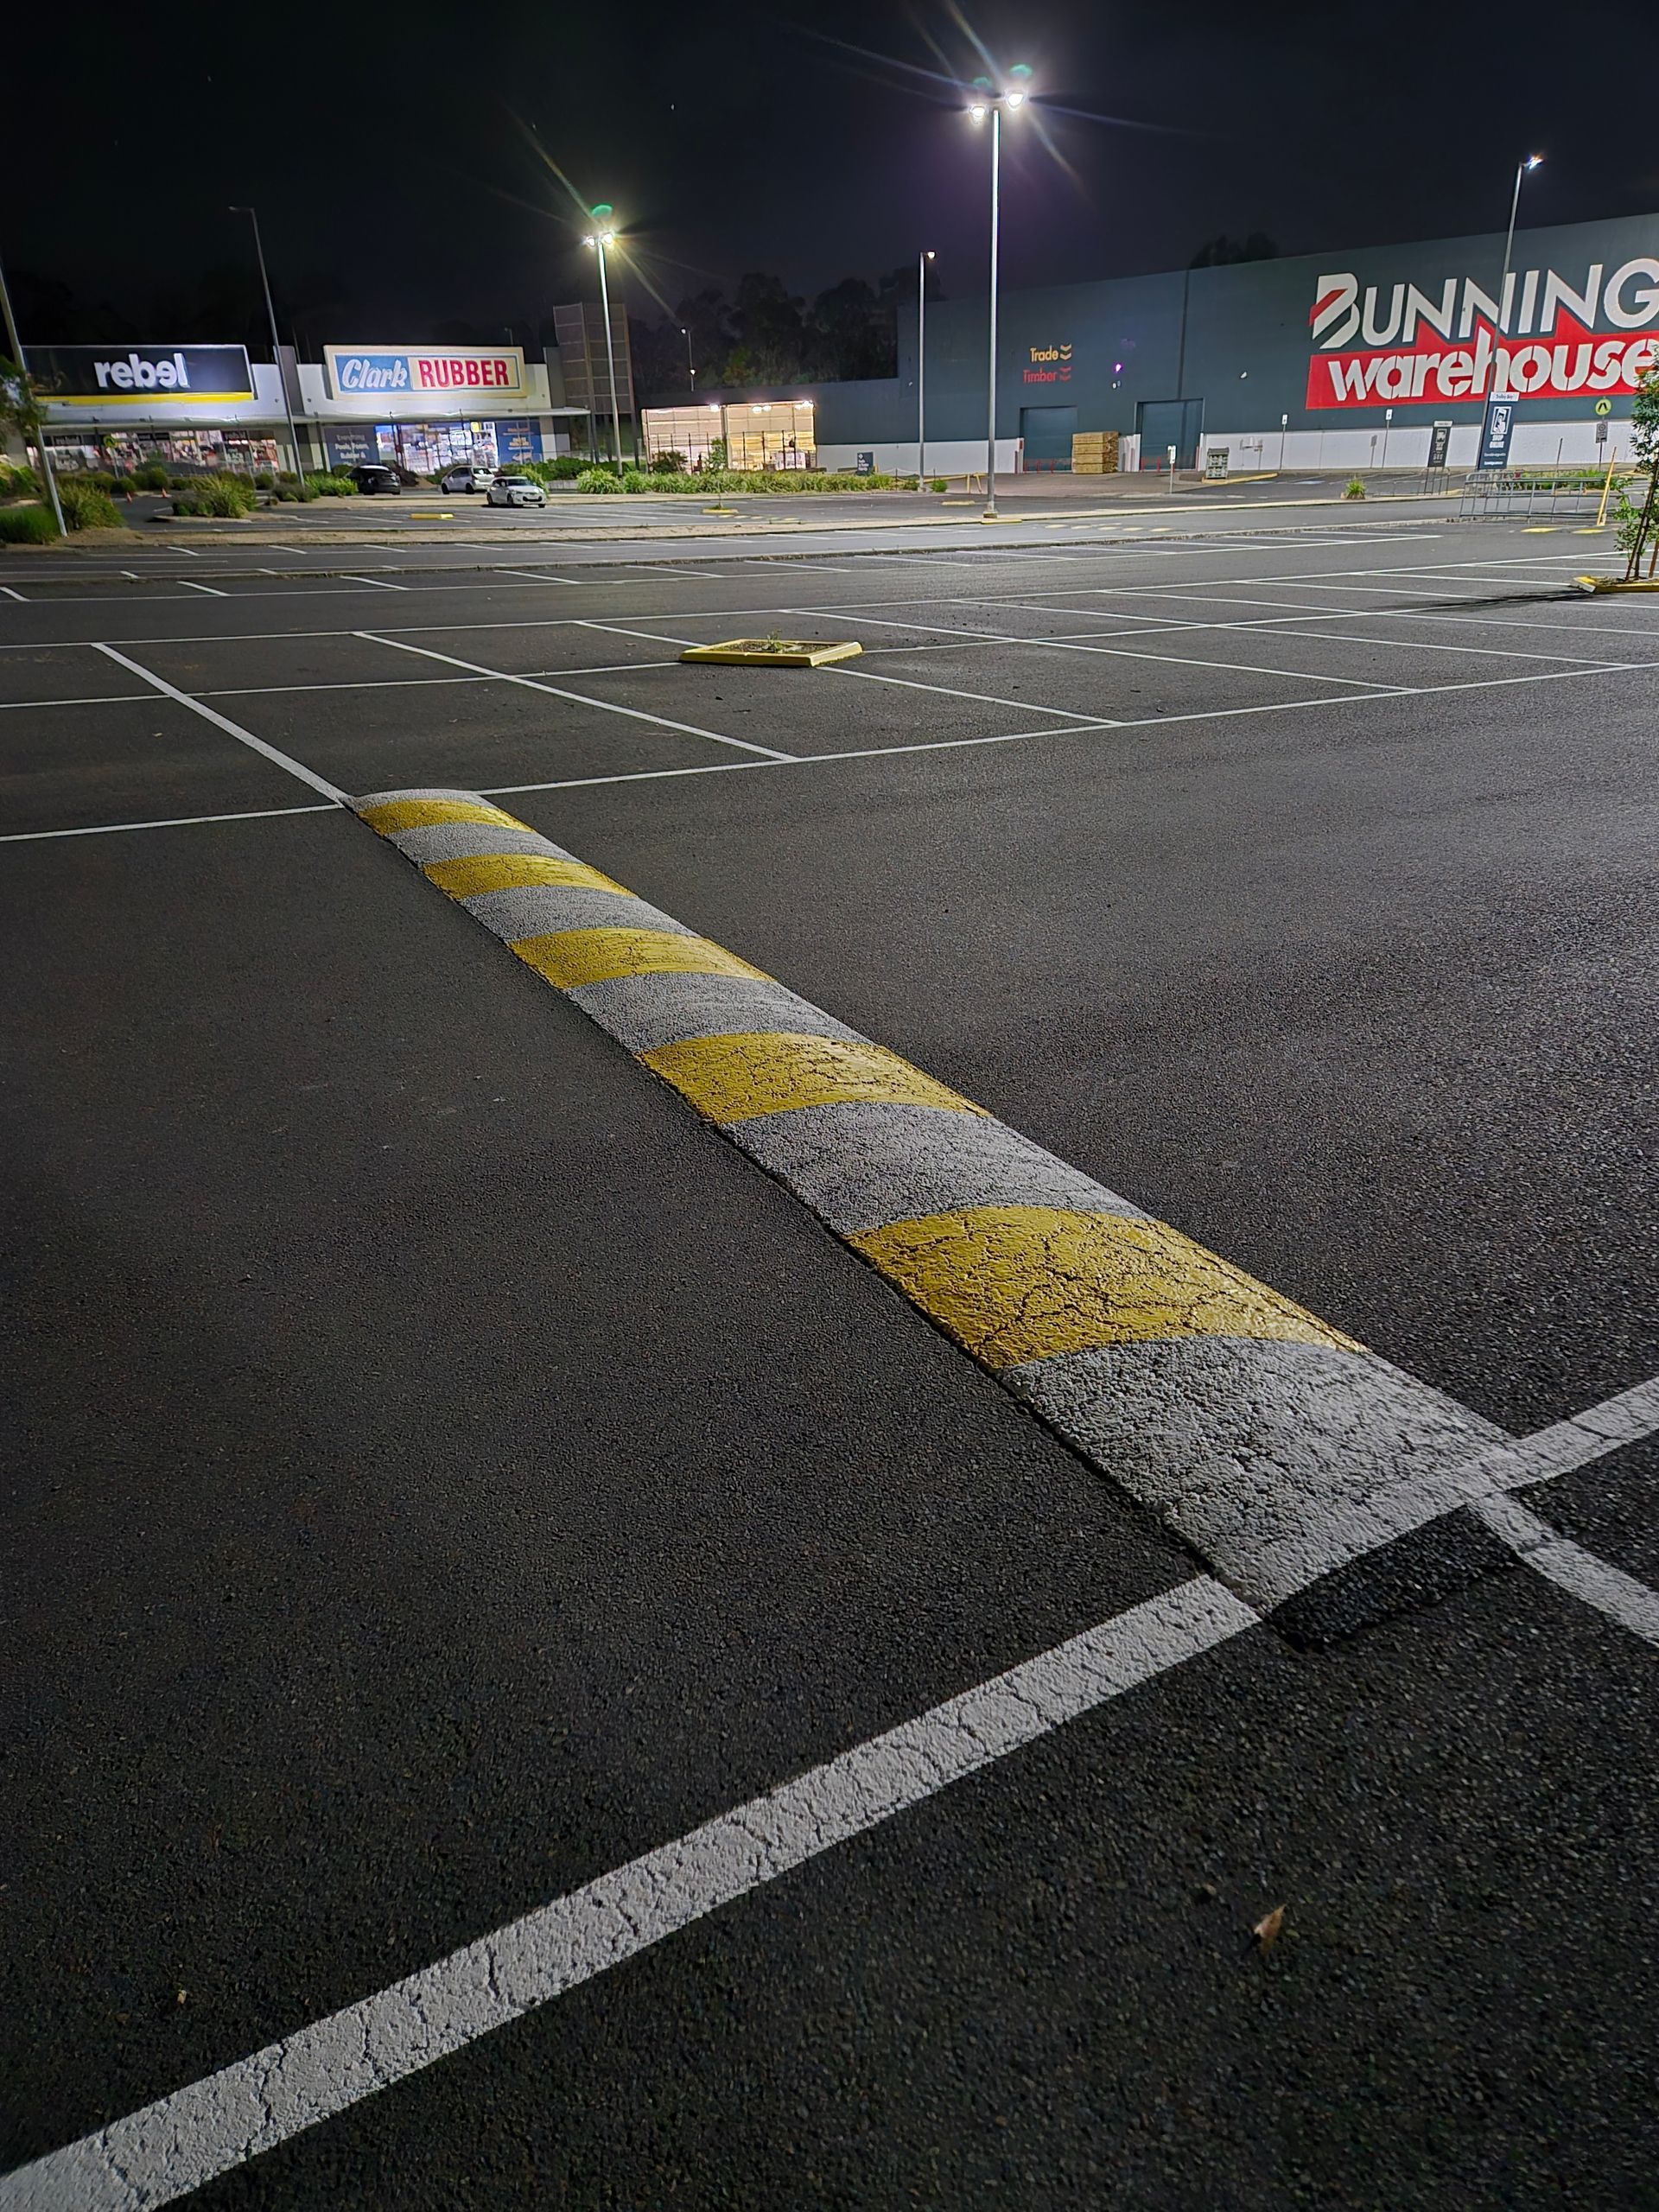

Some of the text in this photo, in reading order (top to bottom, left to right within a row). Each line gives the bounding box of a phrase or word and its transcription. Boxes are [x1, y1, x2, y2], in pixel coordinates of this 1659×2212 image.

[1030, 345, 1058, 362] Trade
[1327, 326, 1659, 401] warehouse
[93, 353, 190, 388] rebel
[342, 359, 510, 389] Clark RUBBER
[1023, 367, 1058, 383] Timber
